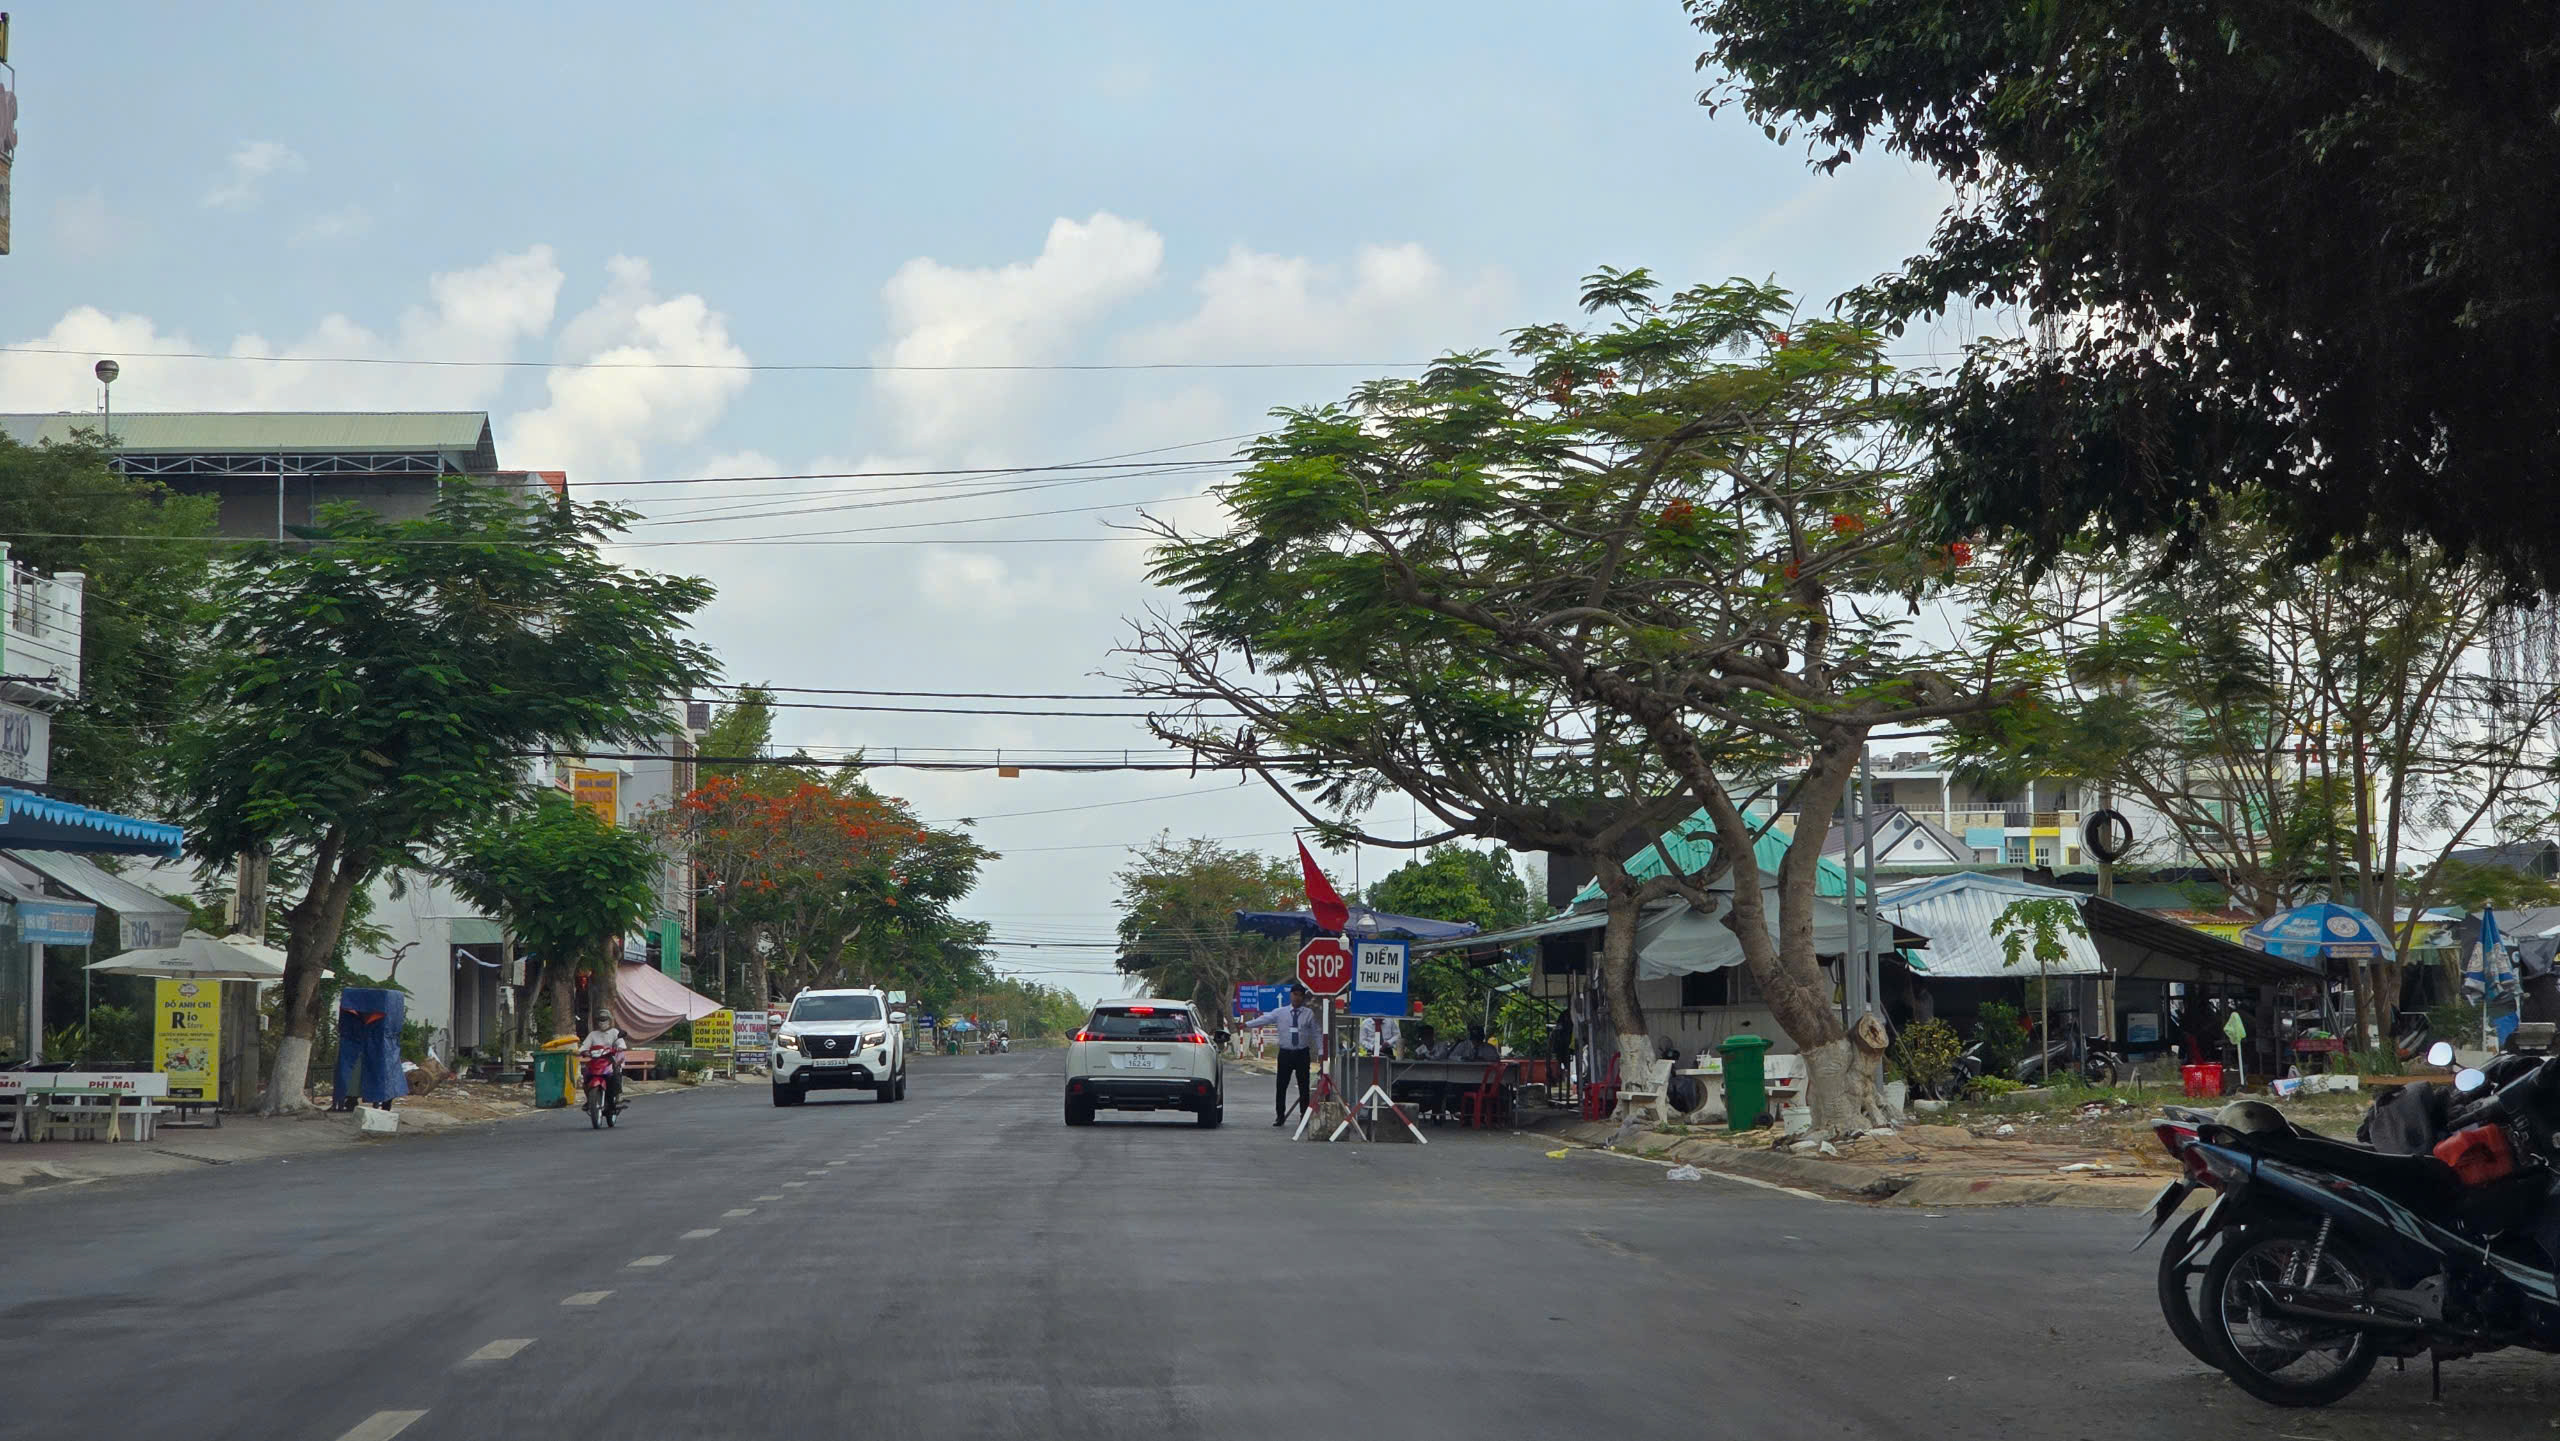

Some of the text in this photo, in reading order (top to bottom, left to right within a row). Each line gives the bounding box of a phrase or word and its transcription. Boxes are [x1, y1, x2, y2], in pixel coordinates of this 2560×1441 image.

[1365, 946, 1399, 966] ĐIỂM
[1306, 955, 1344, 978] STOP
[1360, 970, 1400, 984] THU PHÍ
[89, 1081, 135, 1089] PHI MAI
